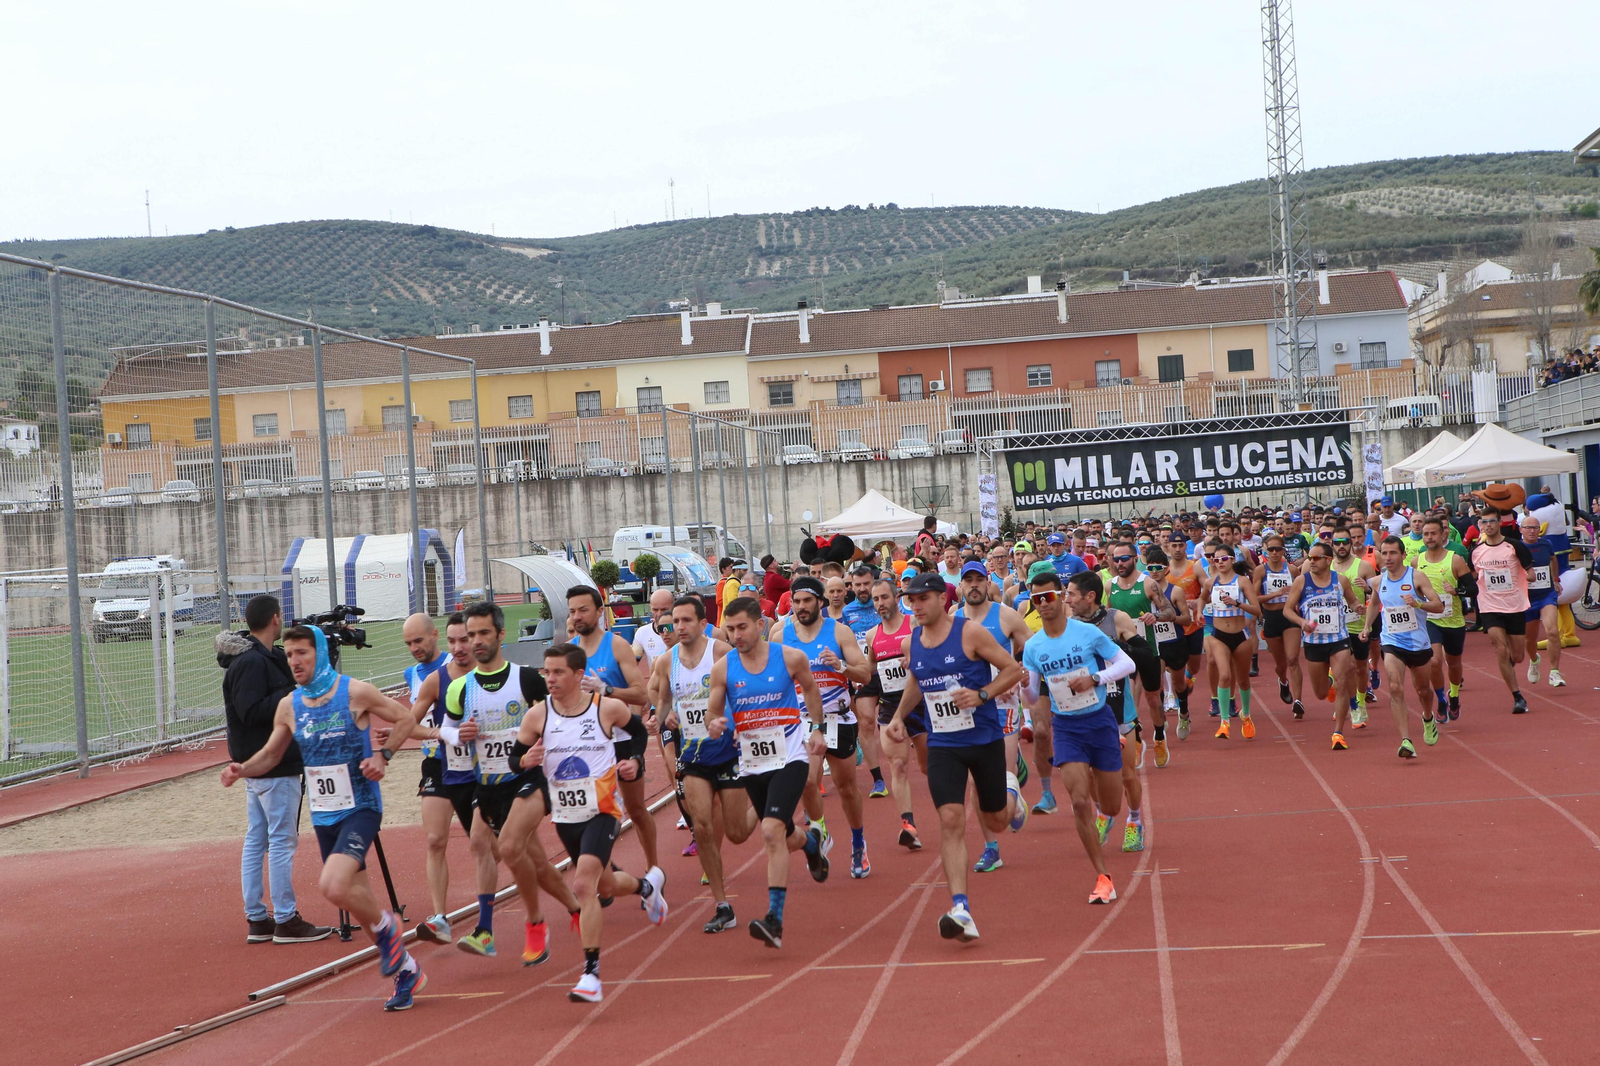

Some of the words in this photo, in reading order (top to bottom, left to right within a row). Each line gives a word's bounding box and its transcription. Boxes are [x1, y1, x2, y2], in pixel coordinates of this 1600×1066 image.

[1054, 450, 1180, 490] MILAR
[1193, 436, 1345, 478] LUCENA
[1016, 492, 1071, 506] NUEVAS
[1272, 579, 1288, 588] 435
[1490, 575, 1506, 584] 618
[1536, 572, 1547, 581] 03
[1318, 615, 1331, 624] 89
[1390, 612, 1410, 624] 889
[1041, 653, 1083, 673] nerja
[885, 667, 906, 680] 940
[736, 691, 782, 705] enerplus
[743, 709, 780, 720] Maratón
[934, 701, 960, 717] 916
[484, 740, 513, 759] 226
[750, 740, 777, 757] 361
[317, 778, 335, 795] 30
[558, 789, 587, 807] 933
